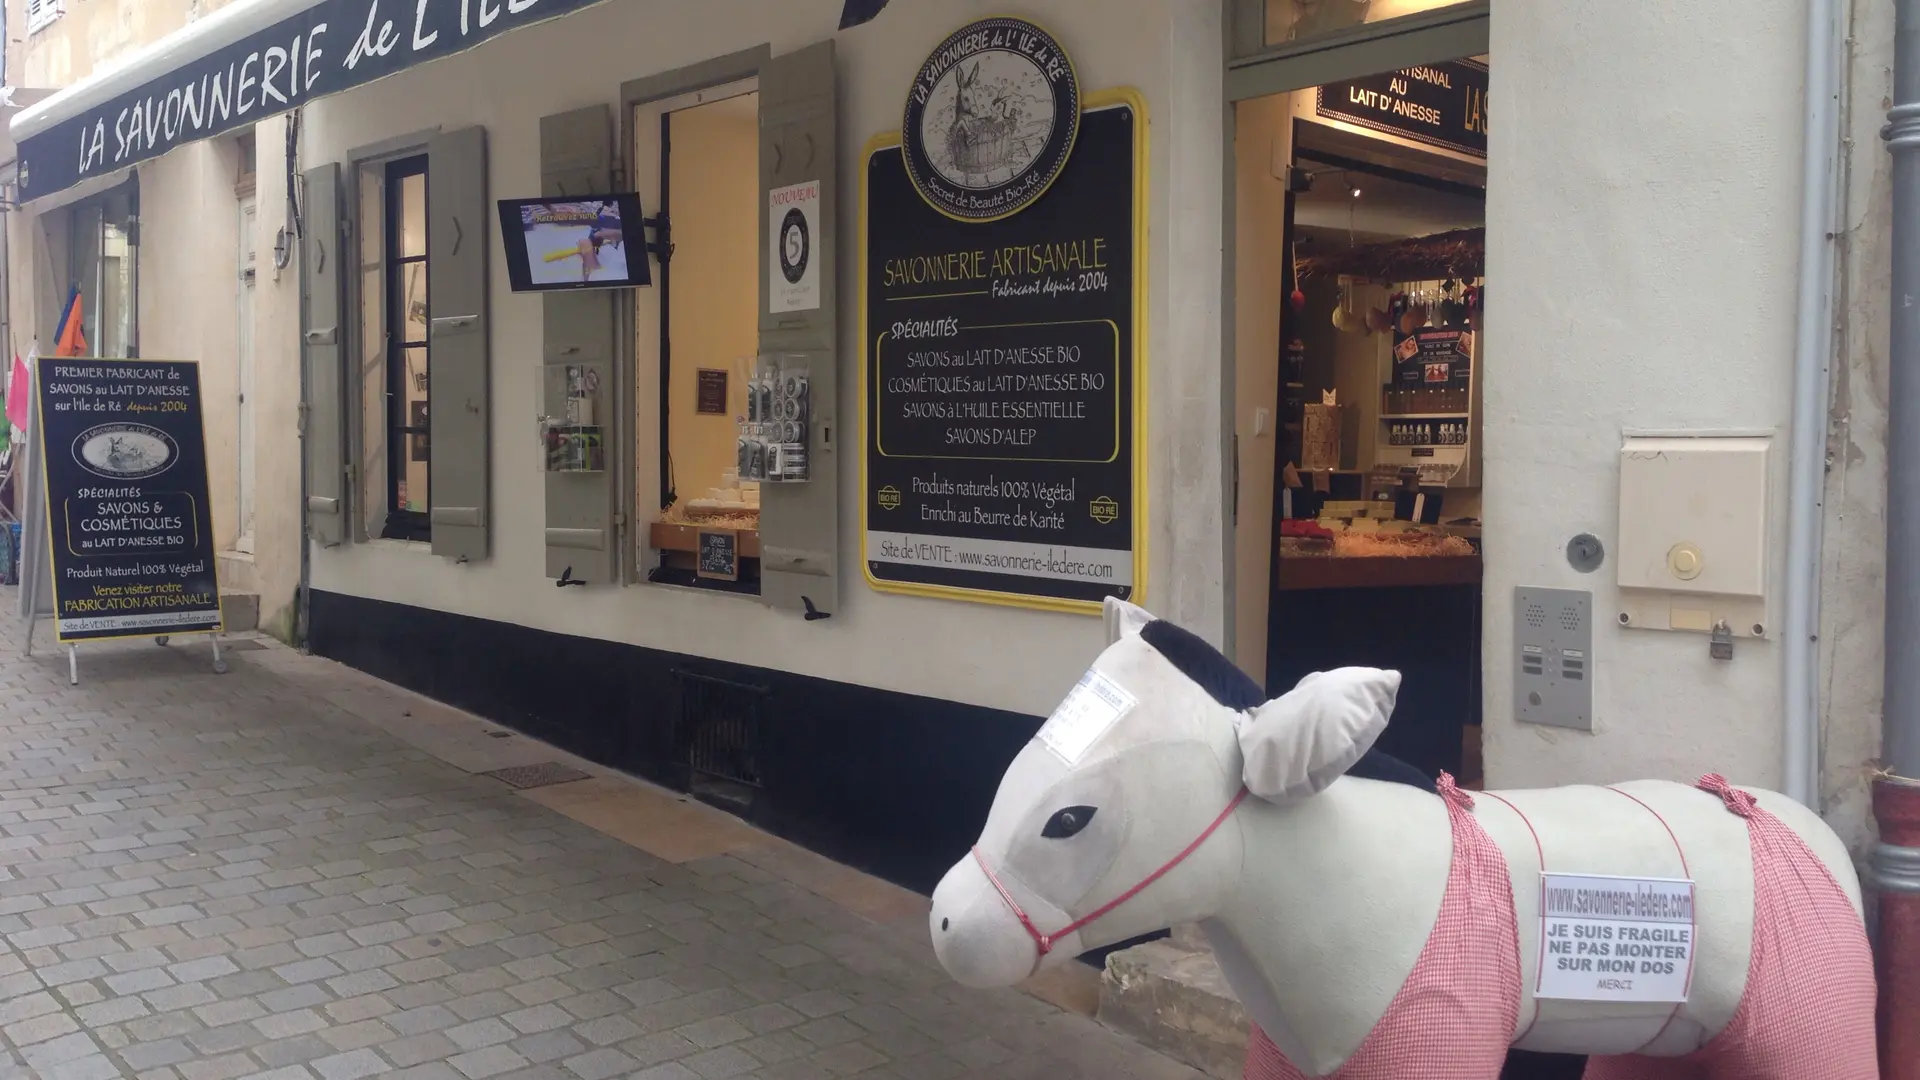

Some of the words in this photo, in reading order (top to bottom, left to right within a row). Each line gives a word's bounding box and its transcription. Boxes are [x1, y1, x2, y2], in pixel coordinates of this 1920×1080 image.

[915, 84, 928, 105] LA
[926, 29, 989, 86] SAVONNERIE
[990, 29, 1002, 47] de
[1034, 46, 1048, 63] de
[79, 117, 104, 174] LA
[115, 23, 327, 163] SAVONNERIE
[342, 0, 400, 69] de
[1350, 86, 1377, 106] LAIT
[1389, 77, 1408, 96] AU
[1464, 85, 1480, 133] LA
[927, 177, 955, 203] Secret
[955, 190, 968, 207] de
[969, 192, 1004, 208] Beauté
[1005, 168, 1041, 202] Bio-Ré
[789, 231, 800, 260] 5
[883, 250, 986, 287] SAVONNERIE
[989, 237, 1107, 277] ARTISANALE
[992, 279, 1040, 298] Fabricant
[1043, 279, 1075, 298] depuis
[1078, 271, 1108, 292] 2004
[891, 316, 959, 340] SPÉCIALITÉS
[907, 351, 950, 368] SAVONS
[951, 354, 964, 367] au
[966, 349, 992, 366] LAIT
[994, 346, 1055, 365] D'ANESSE
[1057, 345, 1081, 363] BIO
[55, 367, 103, 378] PREMIER
[106, 367, 164, 380] FABRICANT
[168, 368, 180, 380] de
[50, 383, 93, 395] SAVONS
[95, 387, 107, 395] au
[110, 385, 133, 395] LAIT
[137, 385, 190, 396] D'ANESSE
[887, 372, 971, 395] COSMÉTIQUES
[972, 379, 985, 392] au
[987, 375, 1013, 392] LAIT
[1016, 373, 1078, 391] D'ANESSE
[1080, 372, 1105, 391] BIO
[55, 403, 71, 411] sur
[94, 399, 106, 411] de
[109, 401, 121, 411] Ré
[127, 401, 157, 413] depuis
[161, 401, 188, 412] 2004
[903, 402, 946, 418] SAVONS
[947, 404, 954, 418] à
[956, 402, 1000, 418] L'HUILE
[1002, 401, 1086, 418] ESSENTIELLE
[945, 427, 991, 444] SAVONS
[993, 428, 1037, 445] D'ALEP
[78, 487, 141, 499] SPÉCIALITÉS
[912, 472, 954, 495] Produits
[956, 474, 999, 497] naturels
[1001, 481, 1030, 499] 100%
[1032, 477, 1075, 508] Végétal
[98, 502, 149, 515] SAVONS
[153, 502, 163, 513] &
[921, 500, 956, 522] Enrichi
[958, 511, 971, 524] au
[974, 507, 1011, 525] Beurre
[1012, 503, 1027, 527] de
[1030, 509, 1065, 530] Karité
[1092, 506, 1105, 515] BIO
[81, 515, 182, 532] COSMÉTIQUES
[82, 540, 93, 548] au
[95, 537, 116, 548] LAIT
[118, 536, 165, 547] D'ANESSE
[167, 535, 184, 545] BIO
[880, 540, 900, 559] Site
[900, 536, 913, 559] de
[914, 543, 952, 563] VENTE
[958, 547, 1113, 578] www.savonnerie-iledere.com
[67, 564, 103, 578] Produit
[105, 562, 140, 577] Naturel
[142, 564, 167, 575] 100%
[169, 559, 204, 577] Végétal
[93, 584, 122, 596] Venez
[124, 583, 153, 595] visiter
[155, 582, 183, 593] notre
[65, 597, 140, 612] FABRICATION
[143, 593, 212, 608] ARTISANALE
[63, 620, 79, 631] Site
[80, 618, 89, 630] de
[1548, 924, 1568, 938] JE
[1573, 924, 1613, 940] SUIS
[1618, 927, 1689, 943] FRAGILE
[1549, 940, 1572, 954] NE
[1577, 942, 1610, 956] PAS
[1615, 943, 1686, 959] MONTER
[1557, 957, 1592, 972] SUR
[1597, 959, 1635, 973] MON
[1640, 961, 1674, 975] DOS
[1596, 979, 1633, 991] MERCI
